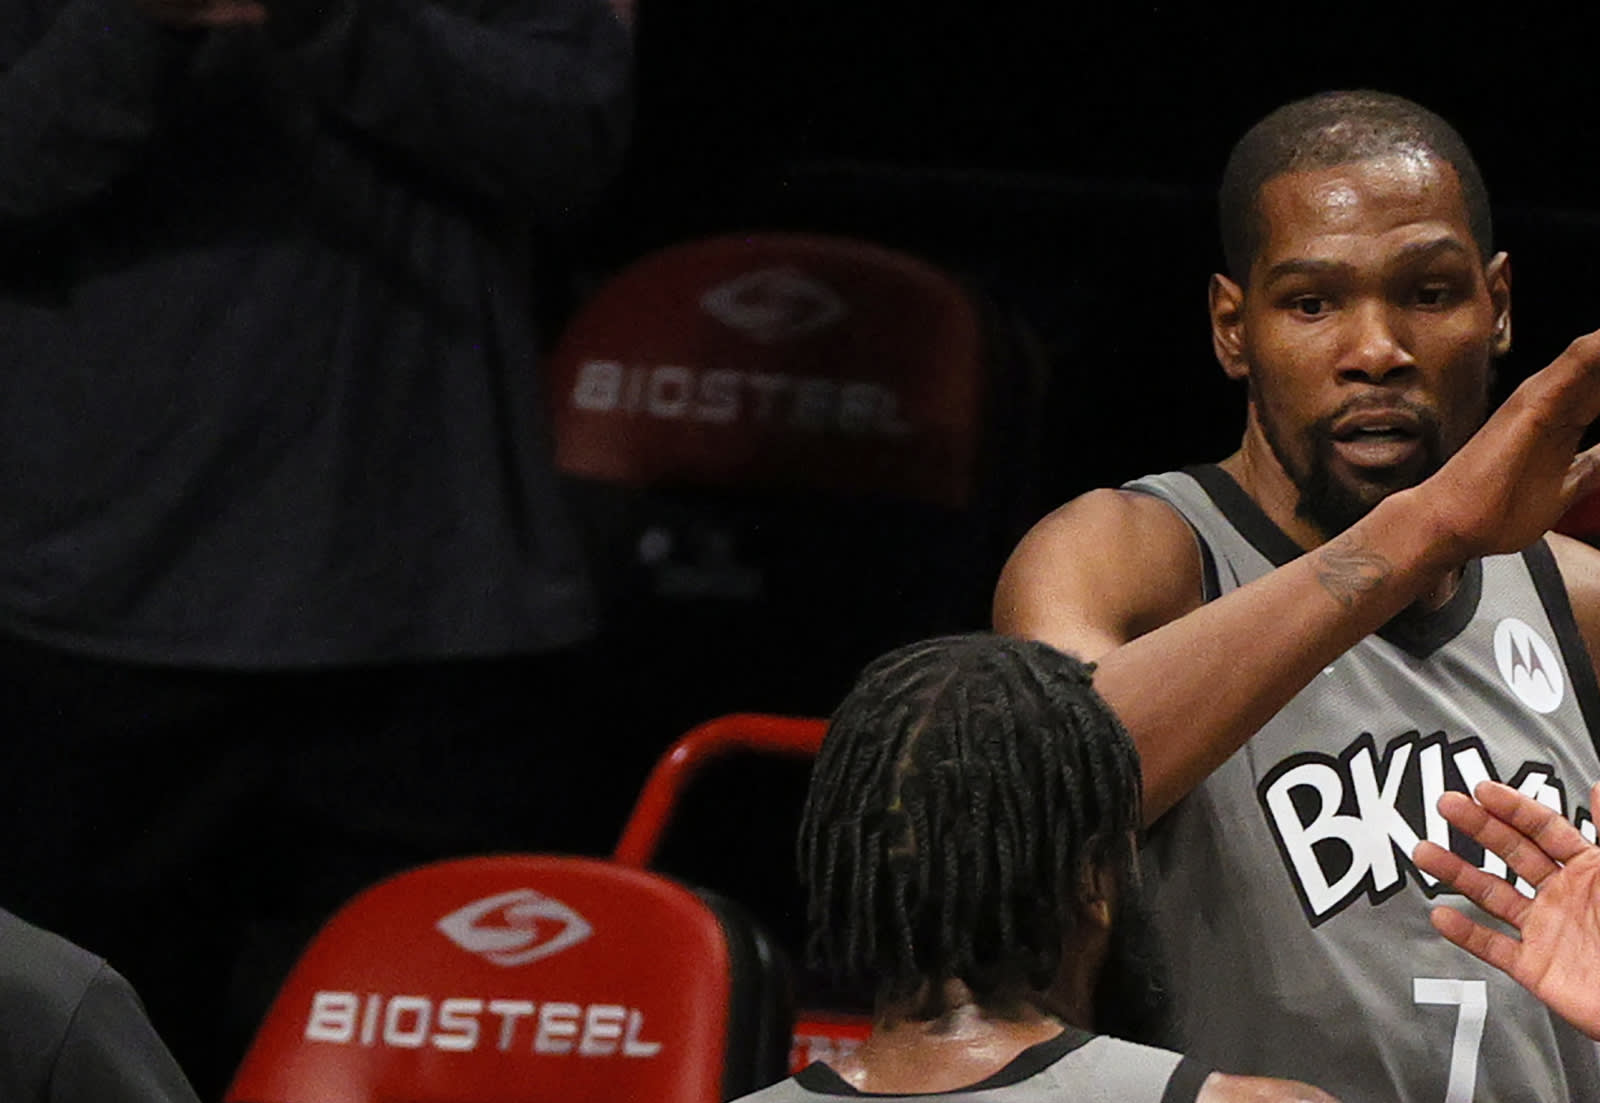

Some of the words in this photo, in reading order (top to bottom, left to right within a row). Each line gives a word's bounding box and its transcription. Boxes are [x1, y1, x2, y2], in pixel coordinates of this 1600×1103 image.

[573, 359, 910, 438] BIOSTEEL
[1257, 730, 1600, 928] BKL
[304, 991, 664, 1058] BIOSTEEL
